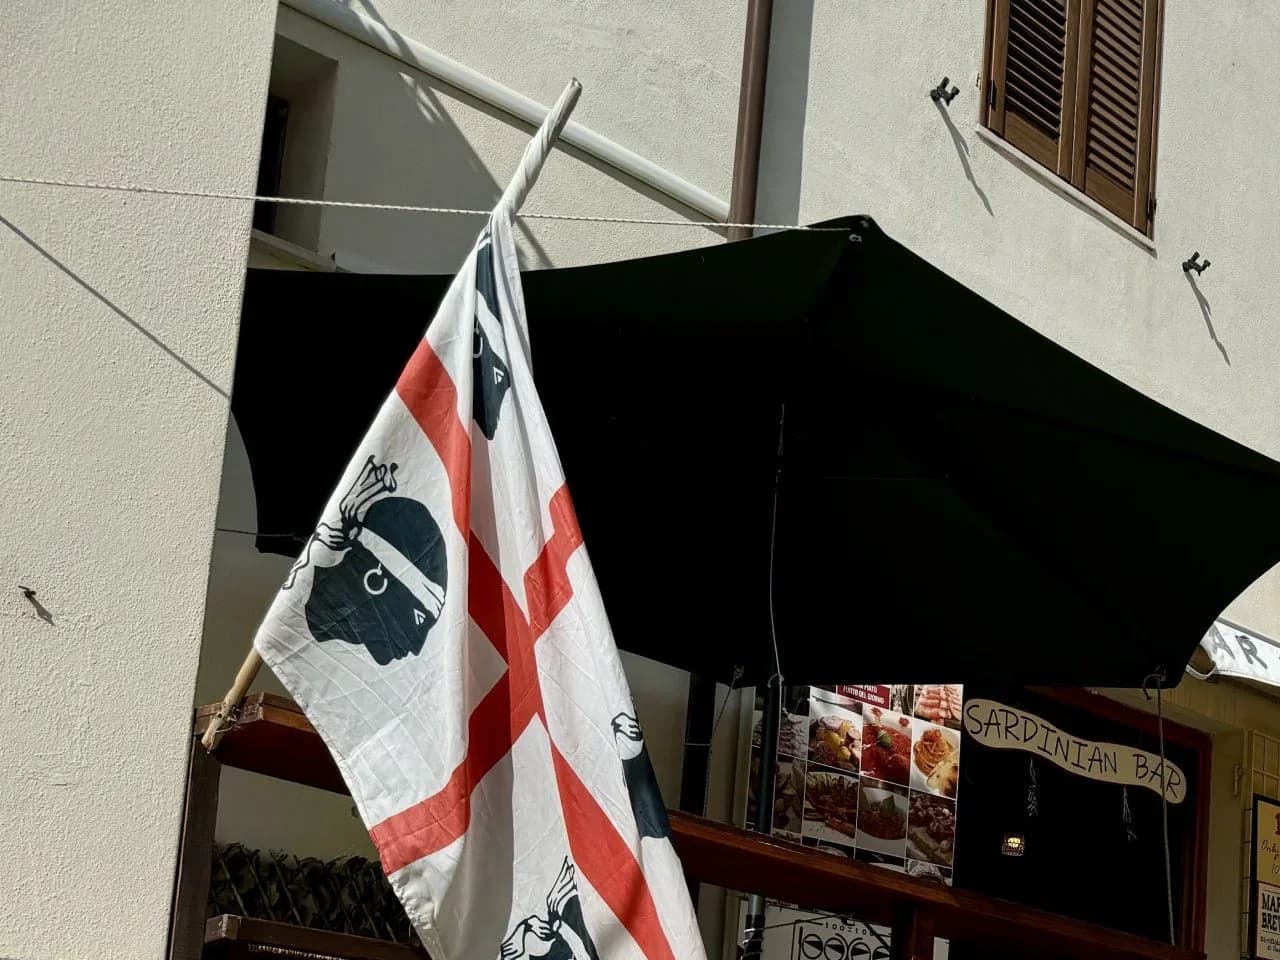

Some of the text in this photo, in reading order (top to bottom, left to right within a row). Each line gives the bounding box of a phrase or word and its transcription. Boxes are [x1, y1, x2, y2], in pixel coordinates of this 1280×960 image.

[1208, 625, 1268, 670] AR
[966, 704, 1182, 799] SARDINIAN BAR
